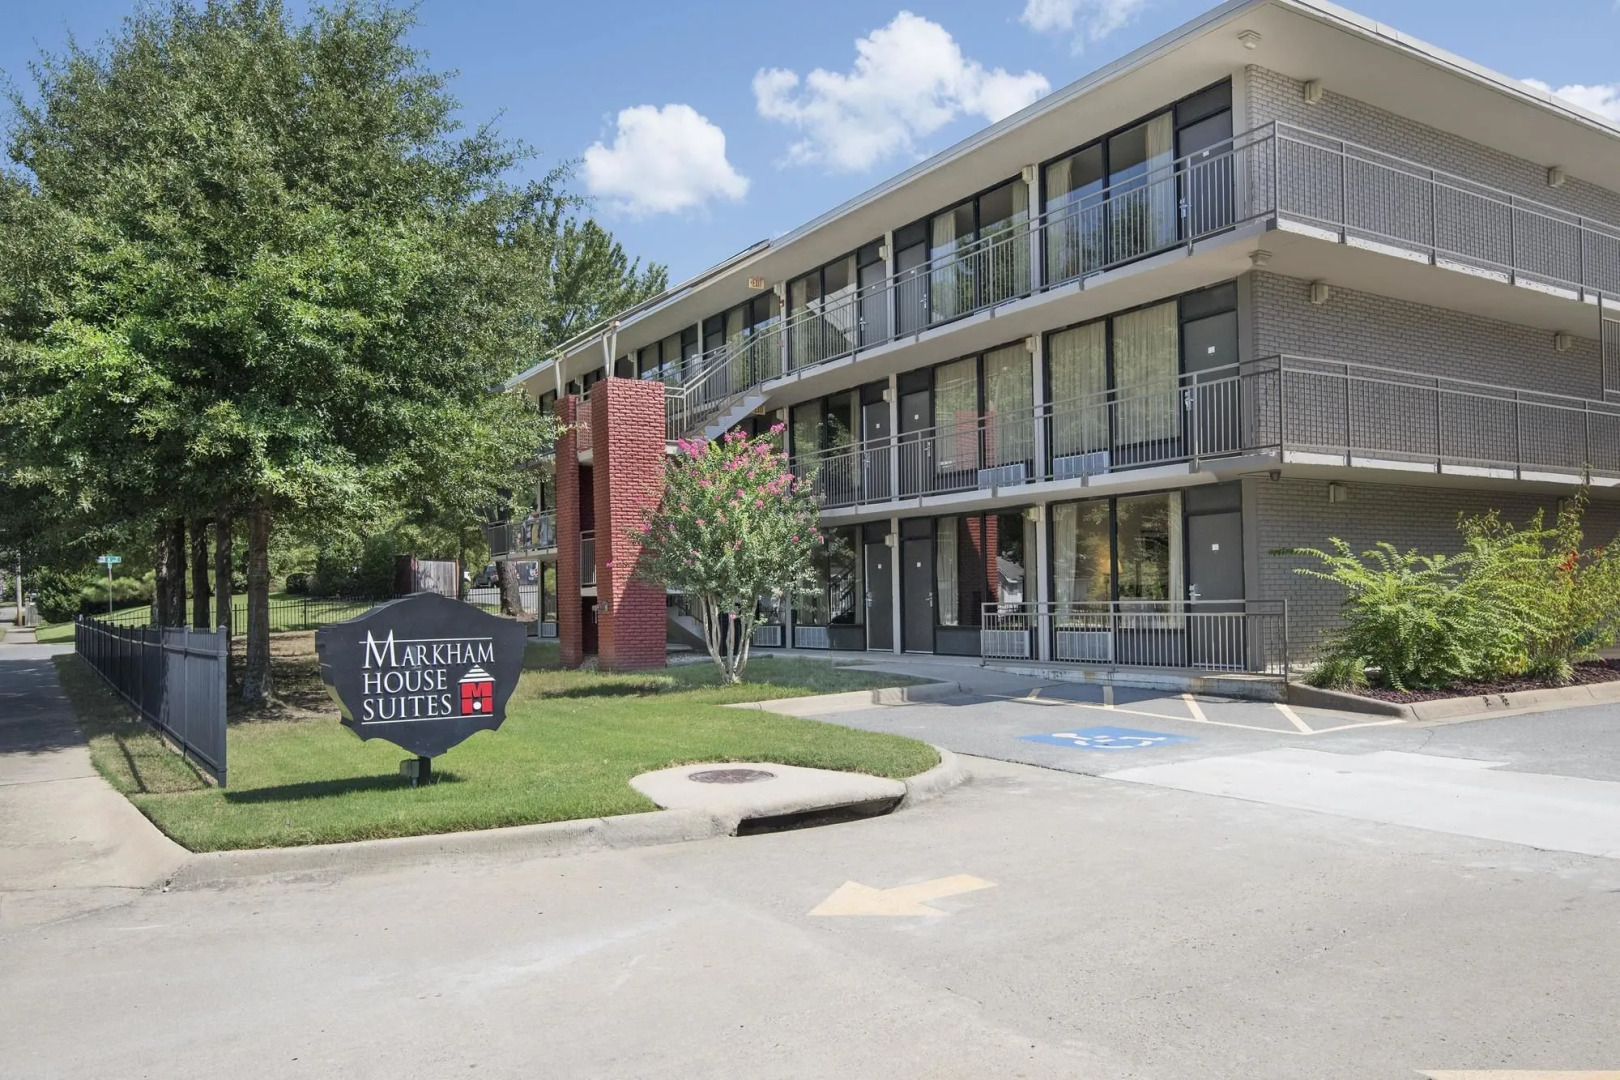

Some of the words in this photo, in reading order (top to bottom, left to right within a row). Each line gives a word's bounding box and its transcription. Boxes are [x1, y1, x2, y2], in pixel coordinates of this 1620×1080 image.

[362, 628, 496, 669] MARKHAM
[362, 669, 448, 695] HOUSE
[362, 693, 452, 721] SUITES
